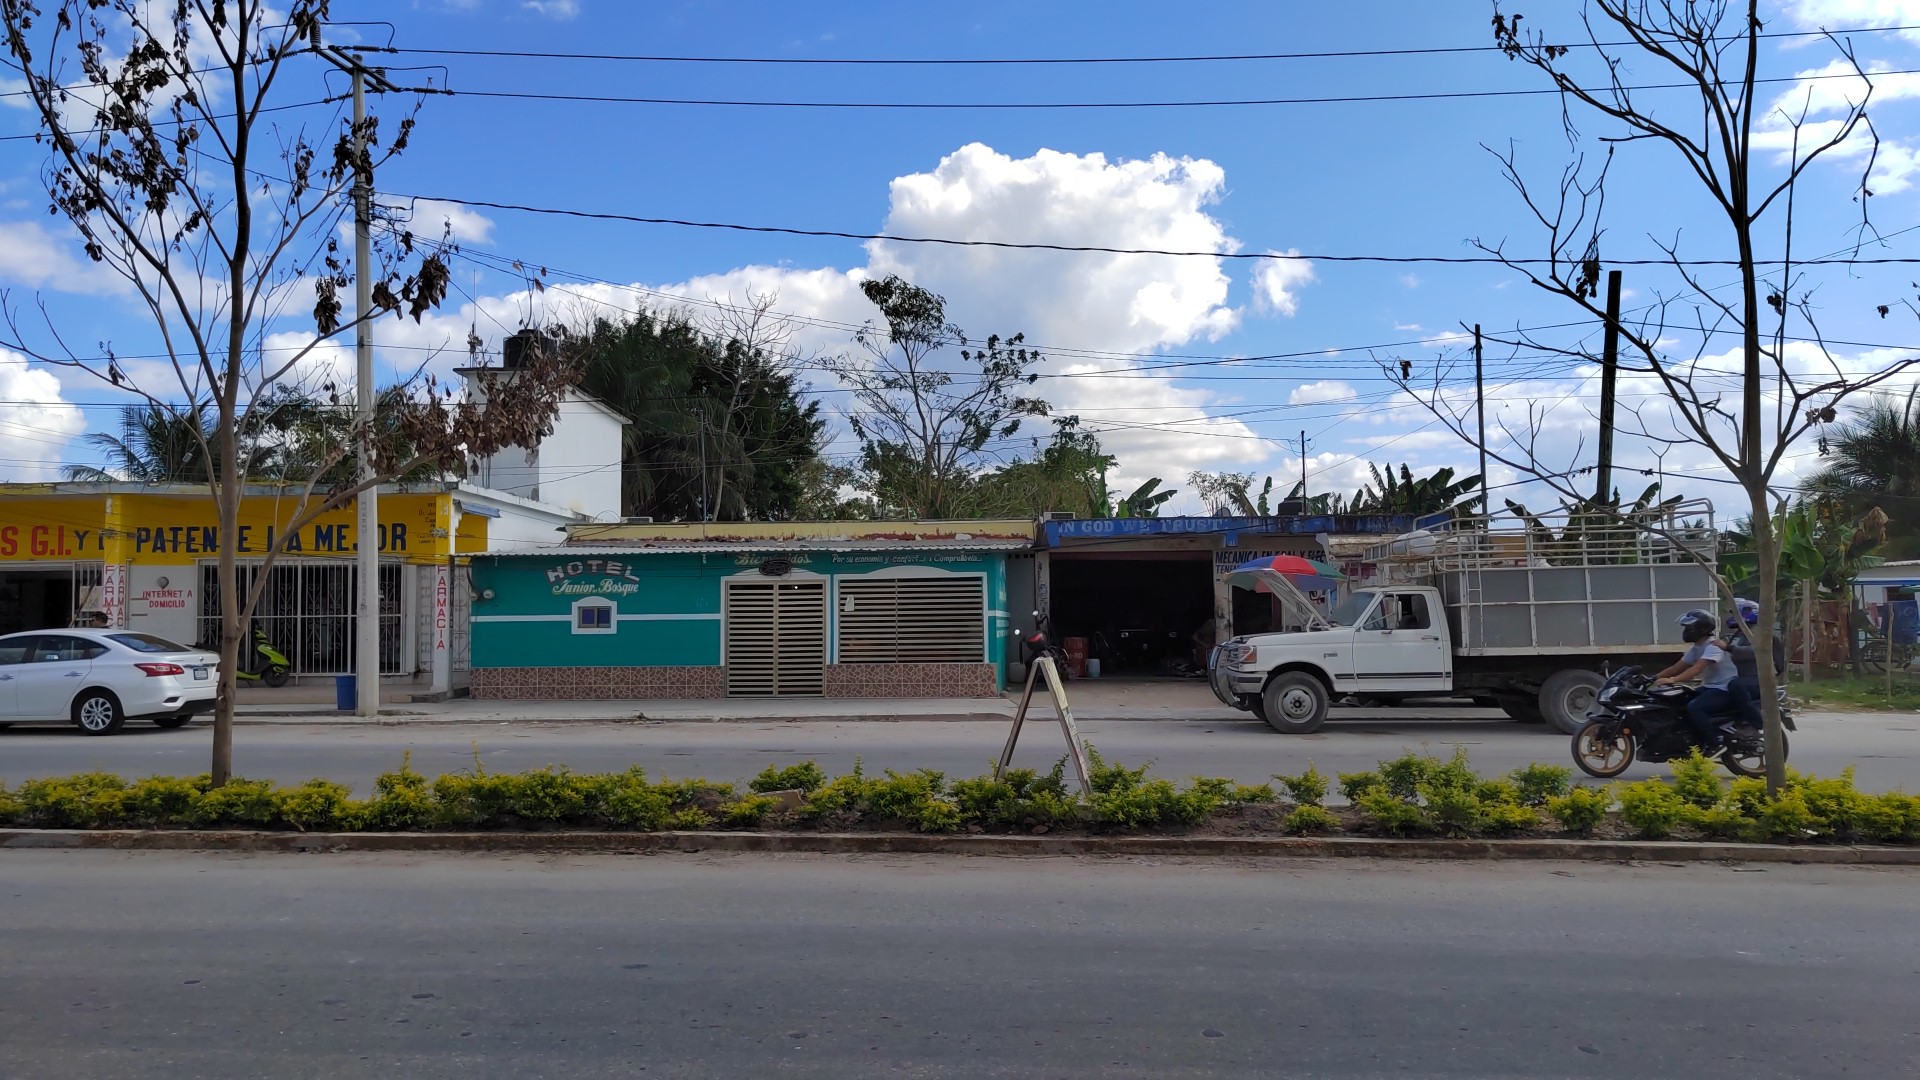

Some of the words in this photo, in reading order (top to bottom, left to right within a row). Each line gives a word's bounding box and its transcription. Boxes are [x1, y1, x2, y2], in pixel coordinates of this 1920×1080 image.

[1081, 520, 1114, 533] GOD
[1120, 520, 1150, 532] WE
[1161, 519, 1223, 531] TRUST
[74, 529, 89, 551] Y
[136, 526, 252, 553] PATENE
[314, 523, 407, 552] MEOR
[1215, 551, 1258, 564] MECANICA
[545, 559, 641, 584] HOTEL
[142, 590, 184, 599] INTERNET
[187, 590, 193, 598] A
[600, 578, 640, 597] Bosque
[149, 599, 186, 609] DOMICILIO
[436, 565, 448, 650] FARMACIA
